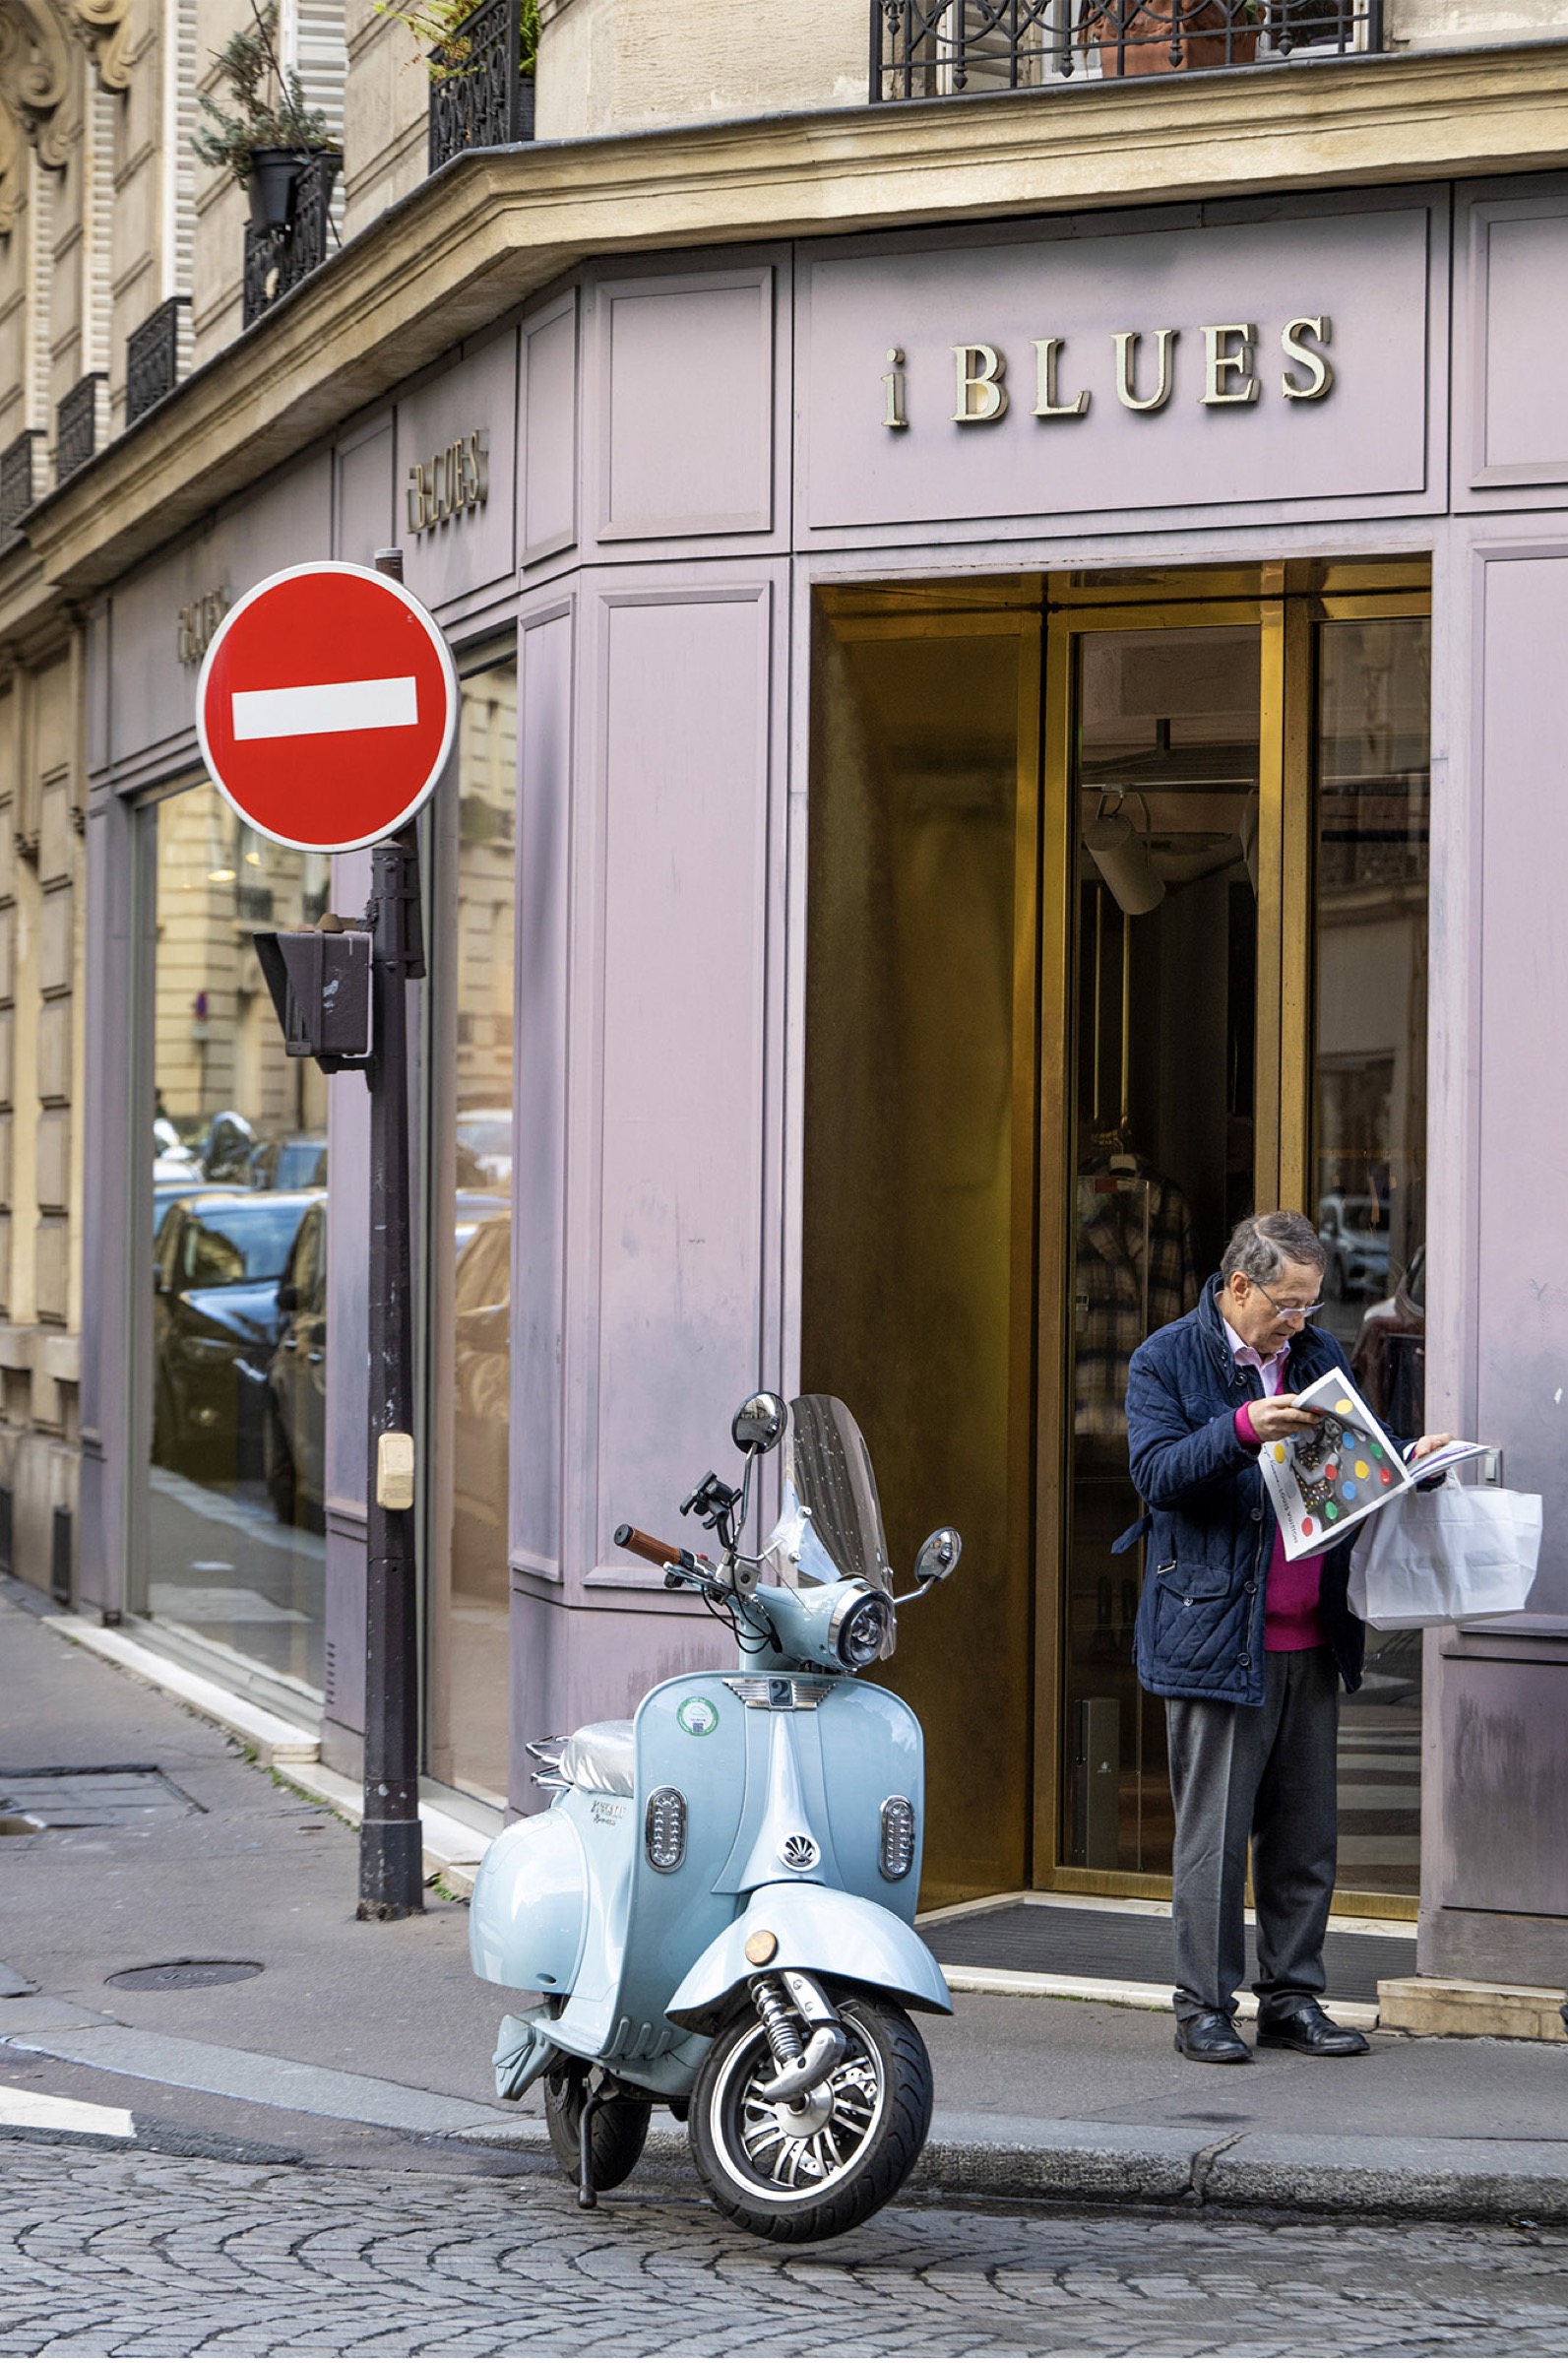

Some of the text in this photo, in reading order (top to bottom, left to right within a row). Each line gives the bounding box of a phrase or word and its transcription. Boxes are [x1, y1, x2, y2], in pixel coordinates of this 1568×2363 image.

[880, 316, 1334, 426] i BLUES
[1280, 1488, 1290, 1512] LOUIS
[771, 1679, 790, 1703] 2
